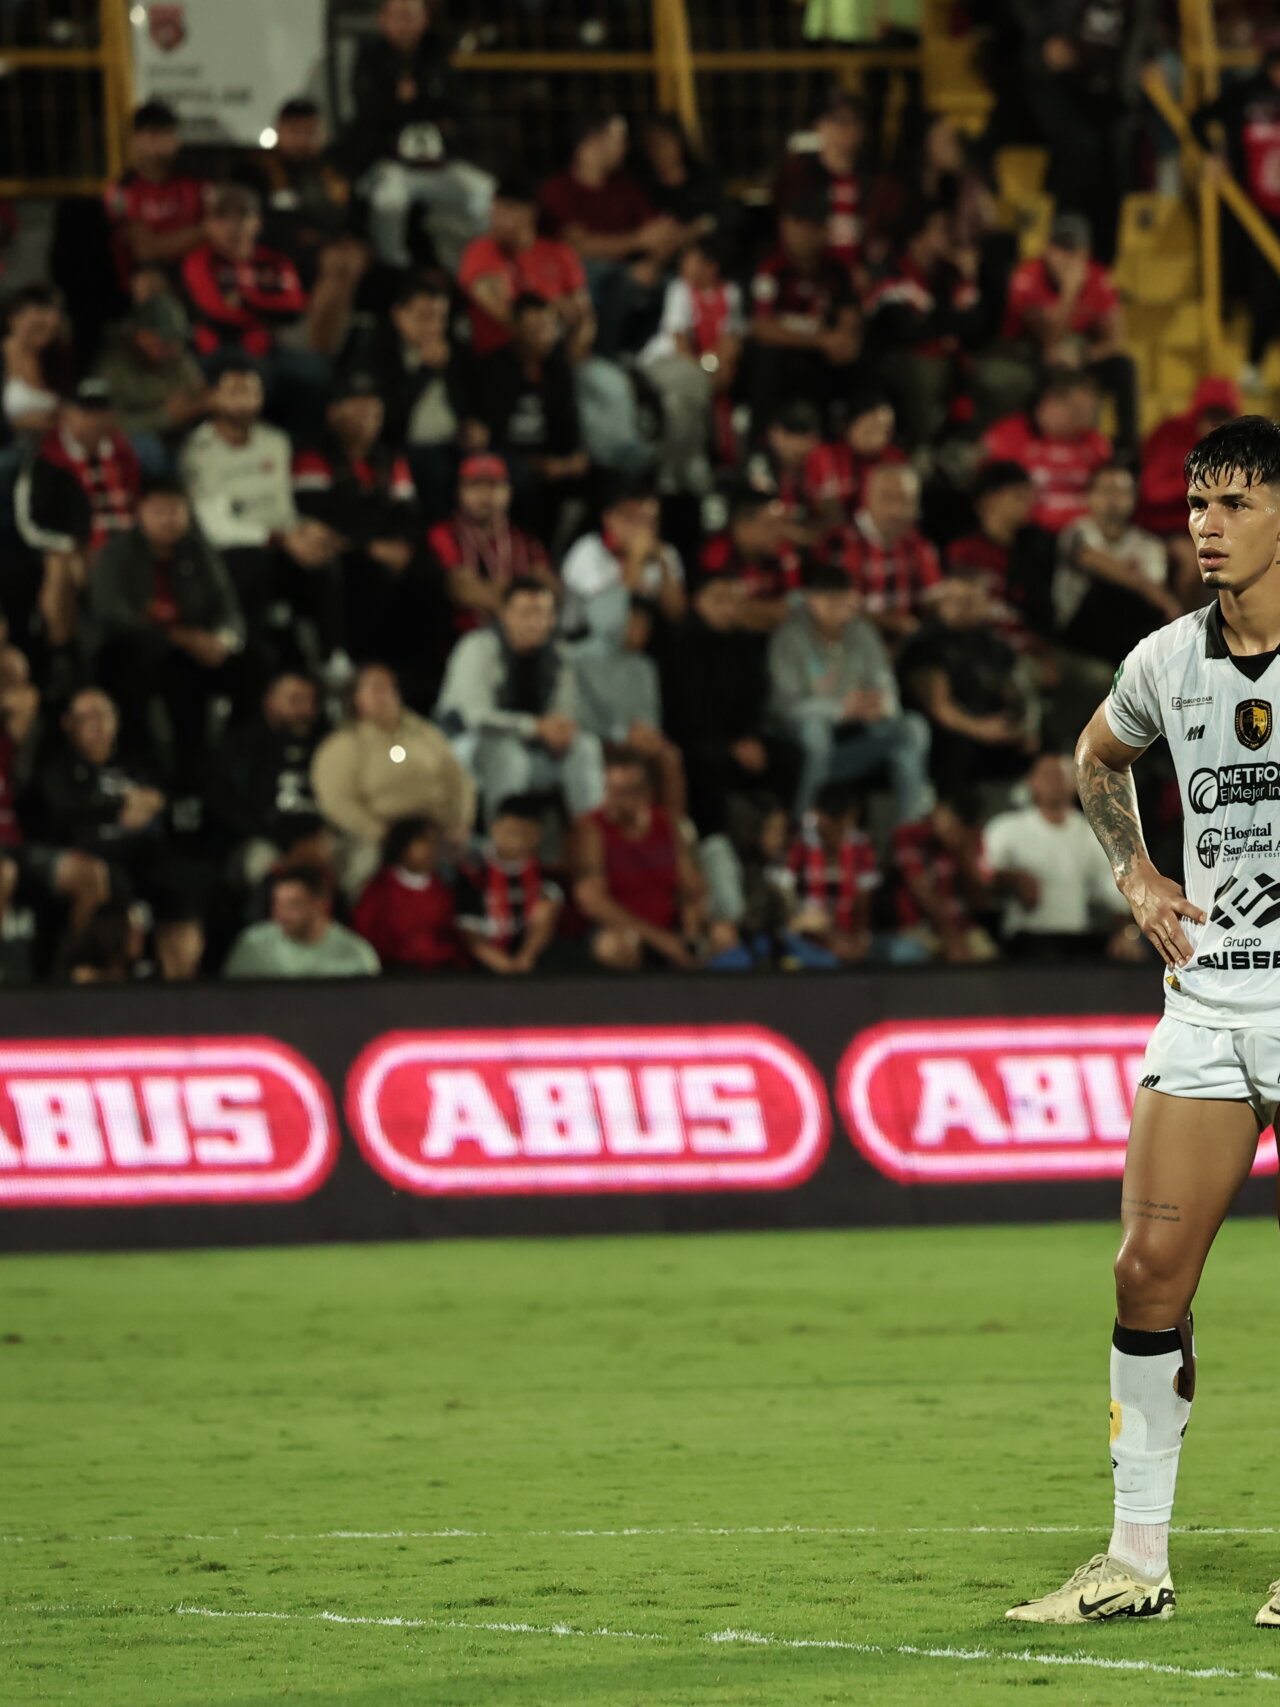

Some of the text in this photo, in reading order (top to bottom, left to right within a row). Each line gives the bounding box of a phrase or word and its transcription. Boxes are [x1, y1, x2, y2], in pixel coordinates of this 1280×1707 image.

[1222, 844, 1242, 857] San
[1222, 936, 1262, 950] Grupo
[0, 1075, 275, 1168] BUS
[420, 1064, 768, 1160] ABUS
